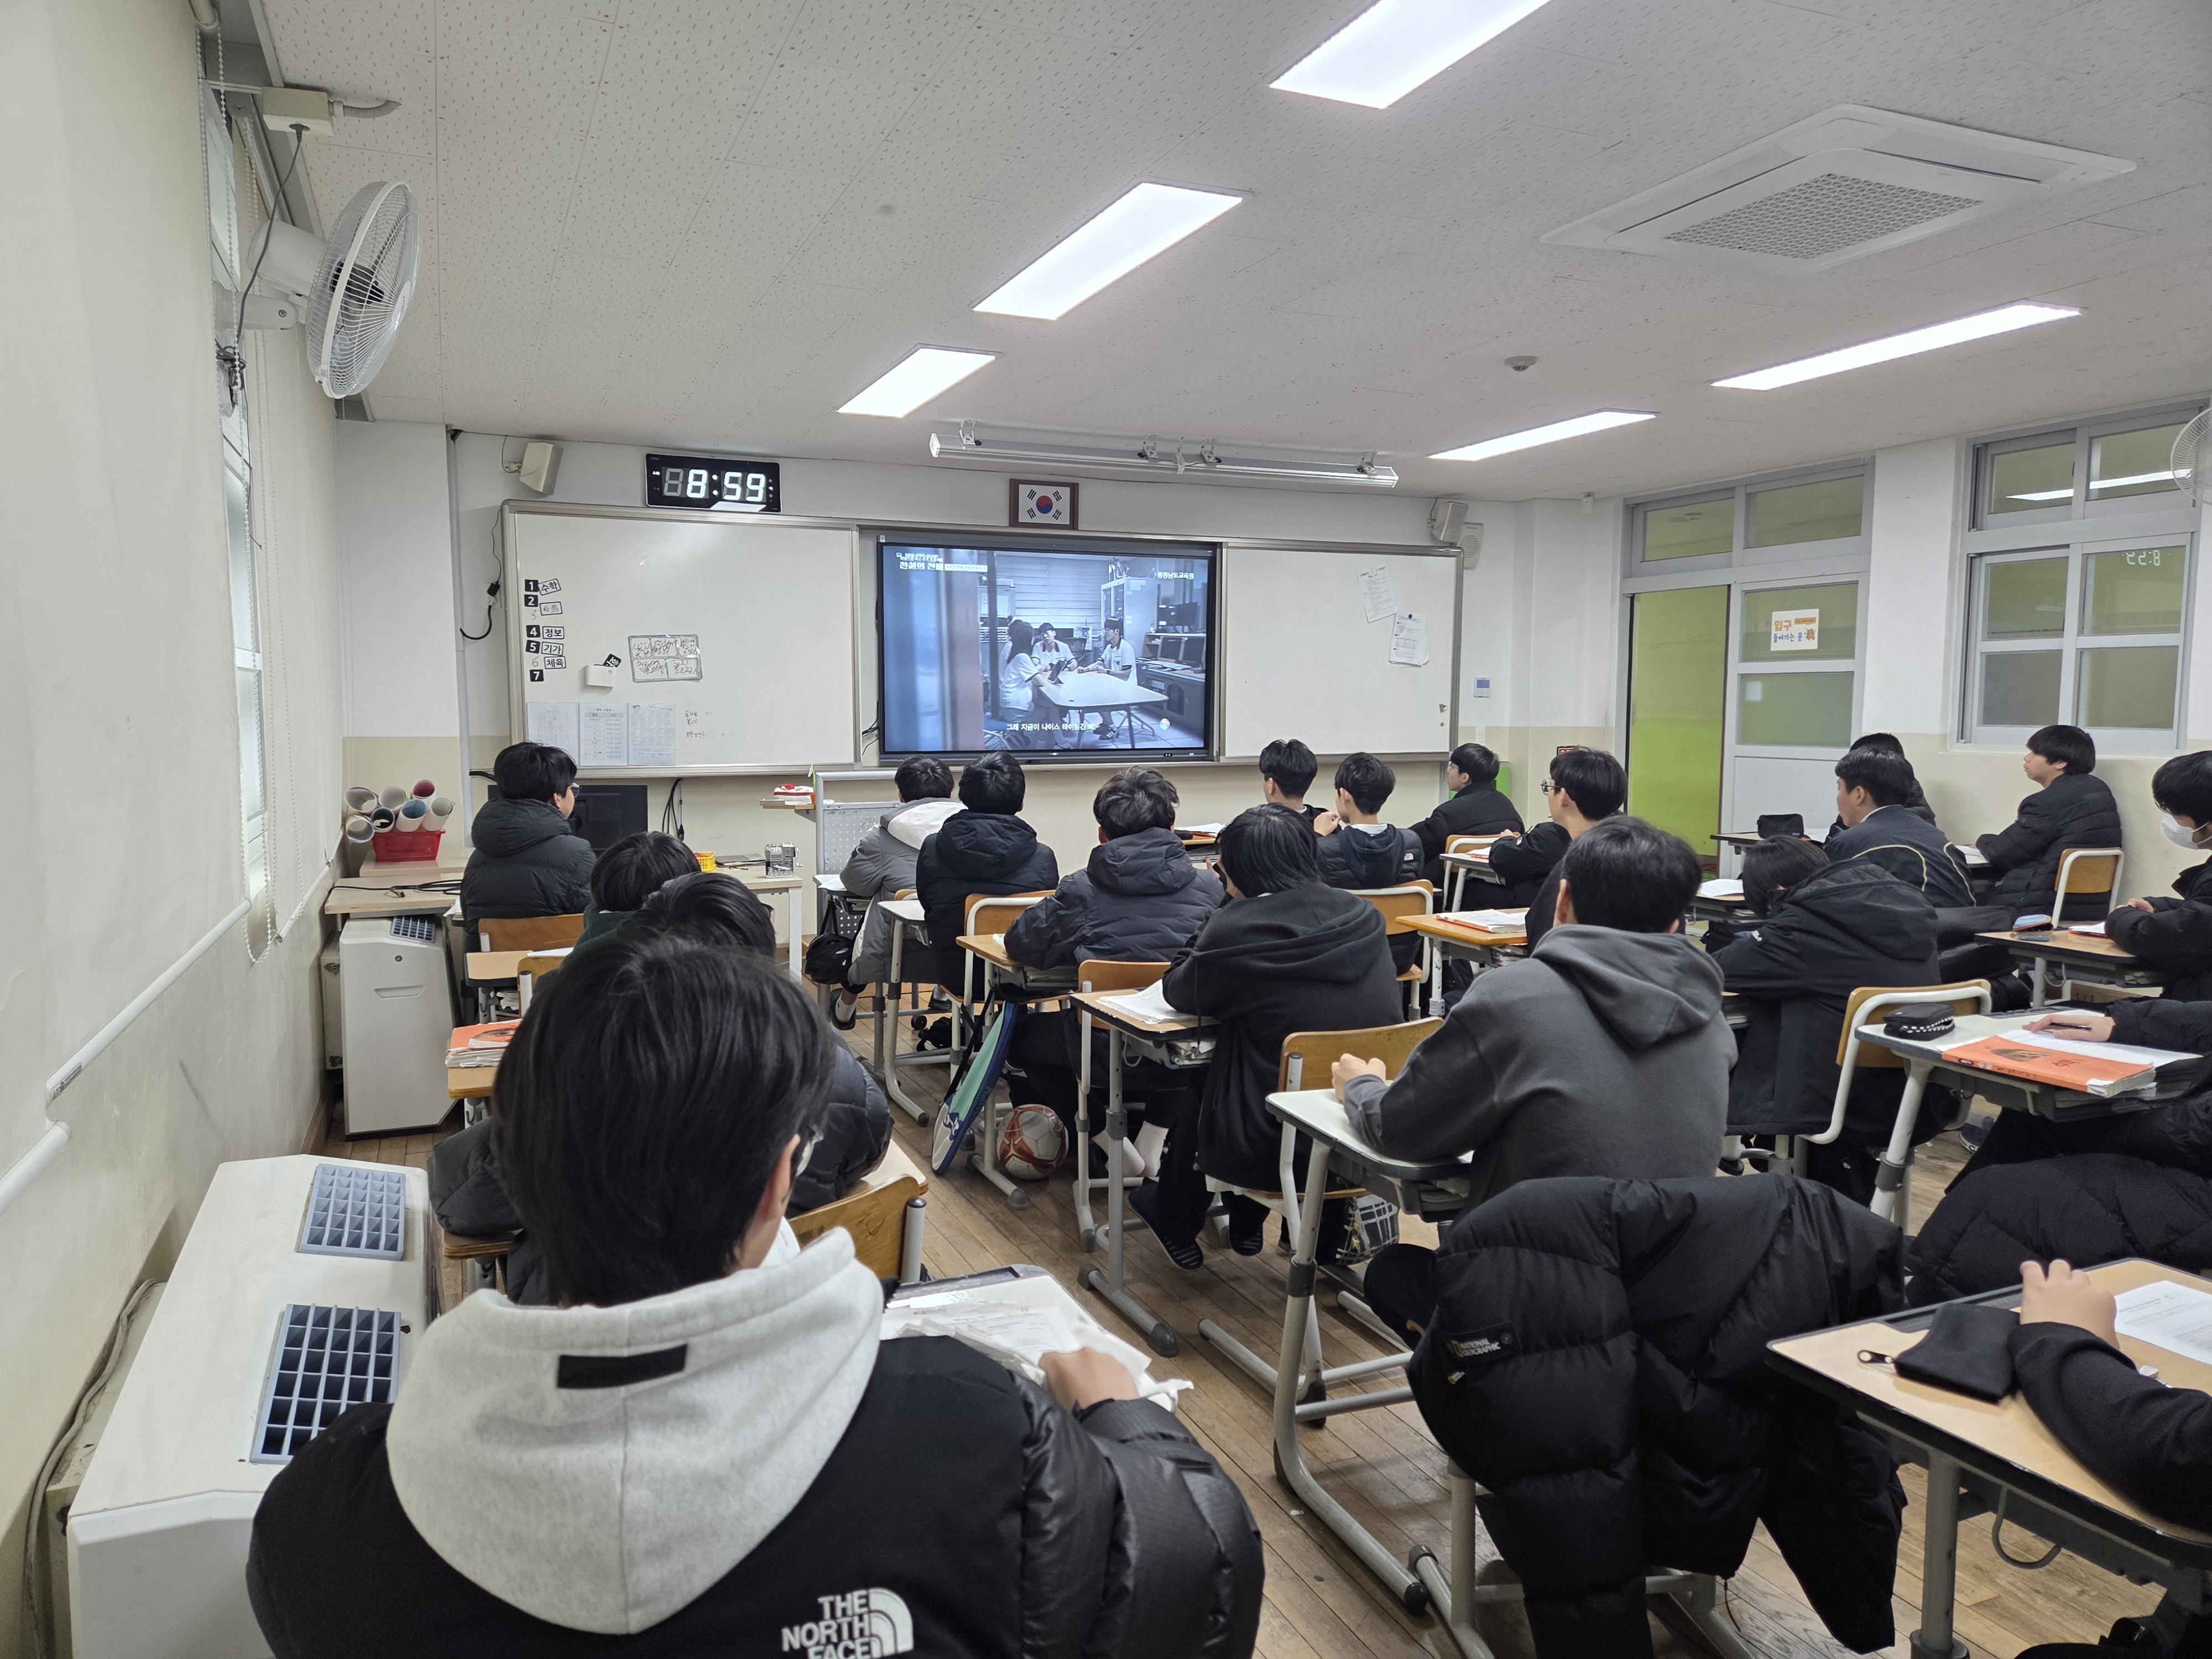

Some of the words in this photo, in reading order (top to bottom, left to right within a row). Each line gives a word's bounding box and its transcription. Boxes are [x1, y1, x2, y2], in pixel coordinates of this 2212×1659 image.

[529, 581, 534, 591] 1
[541, 581, 558, 593] 수학
[528, 596, 535, 606] 2
[531, 609, 537, 620] 3
[1774, 620, 1792, 632] 입구
[530, 627, 538, 637] 4
[545, 629, 562, 638] 정보
[529, 642, 536, 651] 5
[544, 644, 561, 654] 기가
[532, 656, 539, 667] 6
[546, 658, 564, 667] 체육
[533, 671, 540, 680] 7
[1459, 1338, 1491, 1349] NATIONAL
[1462, 1342, 1501, 1357] GEOGRAPHIC
[817, 1589, 869, 1620] THE
[781, 1613, 870, 1652] NORTH
[807, 1637, 870, 1659] FACE
